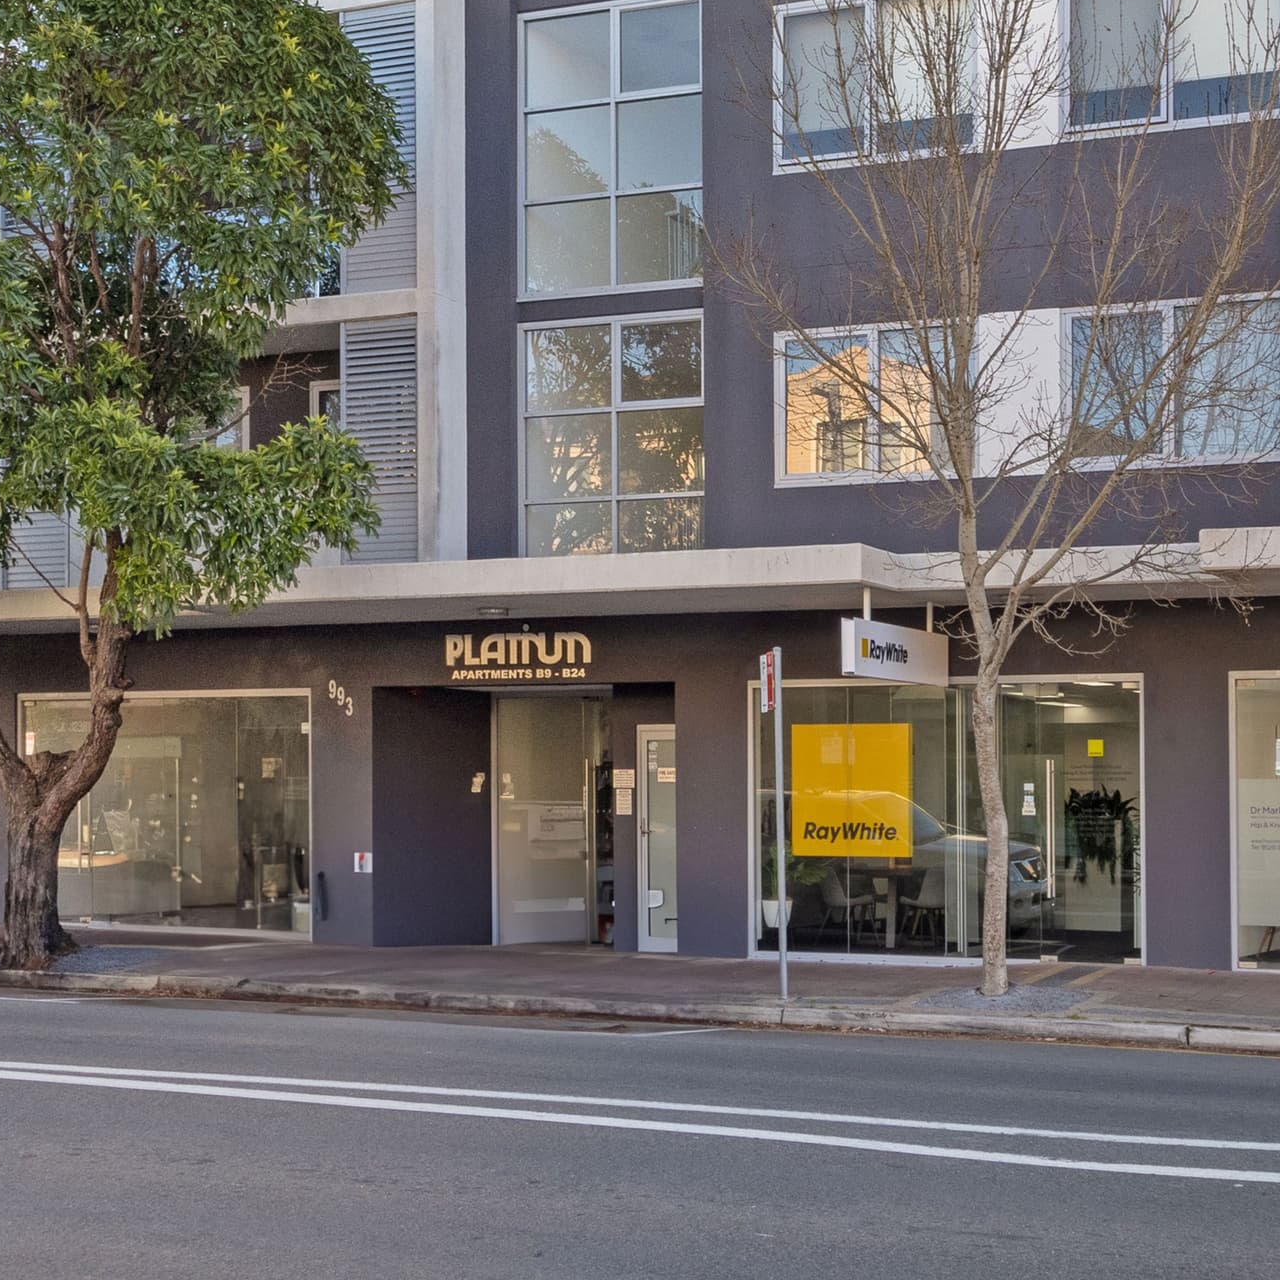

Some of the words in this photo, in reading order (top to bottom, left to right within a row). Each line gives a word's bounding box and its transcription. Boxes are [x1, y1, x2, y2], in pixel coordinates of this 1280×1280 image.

[452, 669, 532, 680] APARTMENTS
[536, 669, 552, 678] B9
[562, 668, 586, 678] B24
[328, 679, 353, 716] 993
